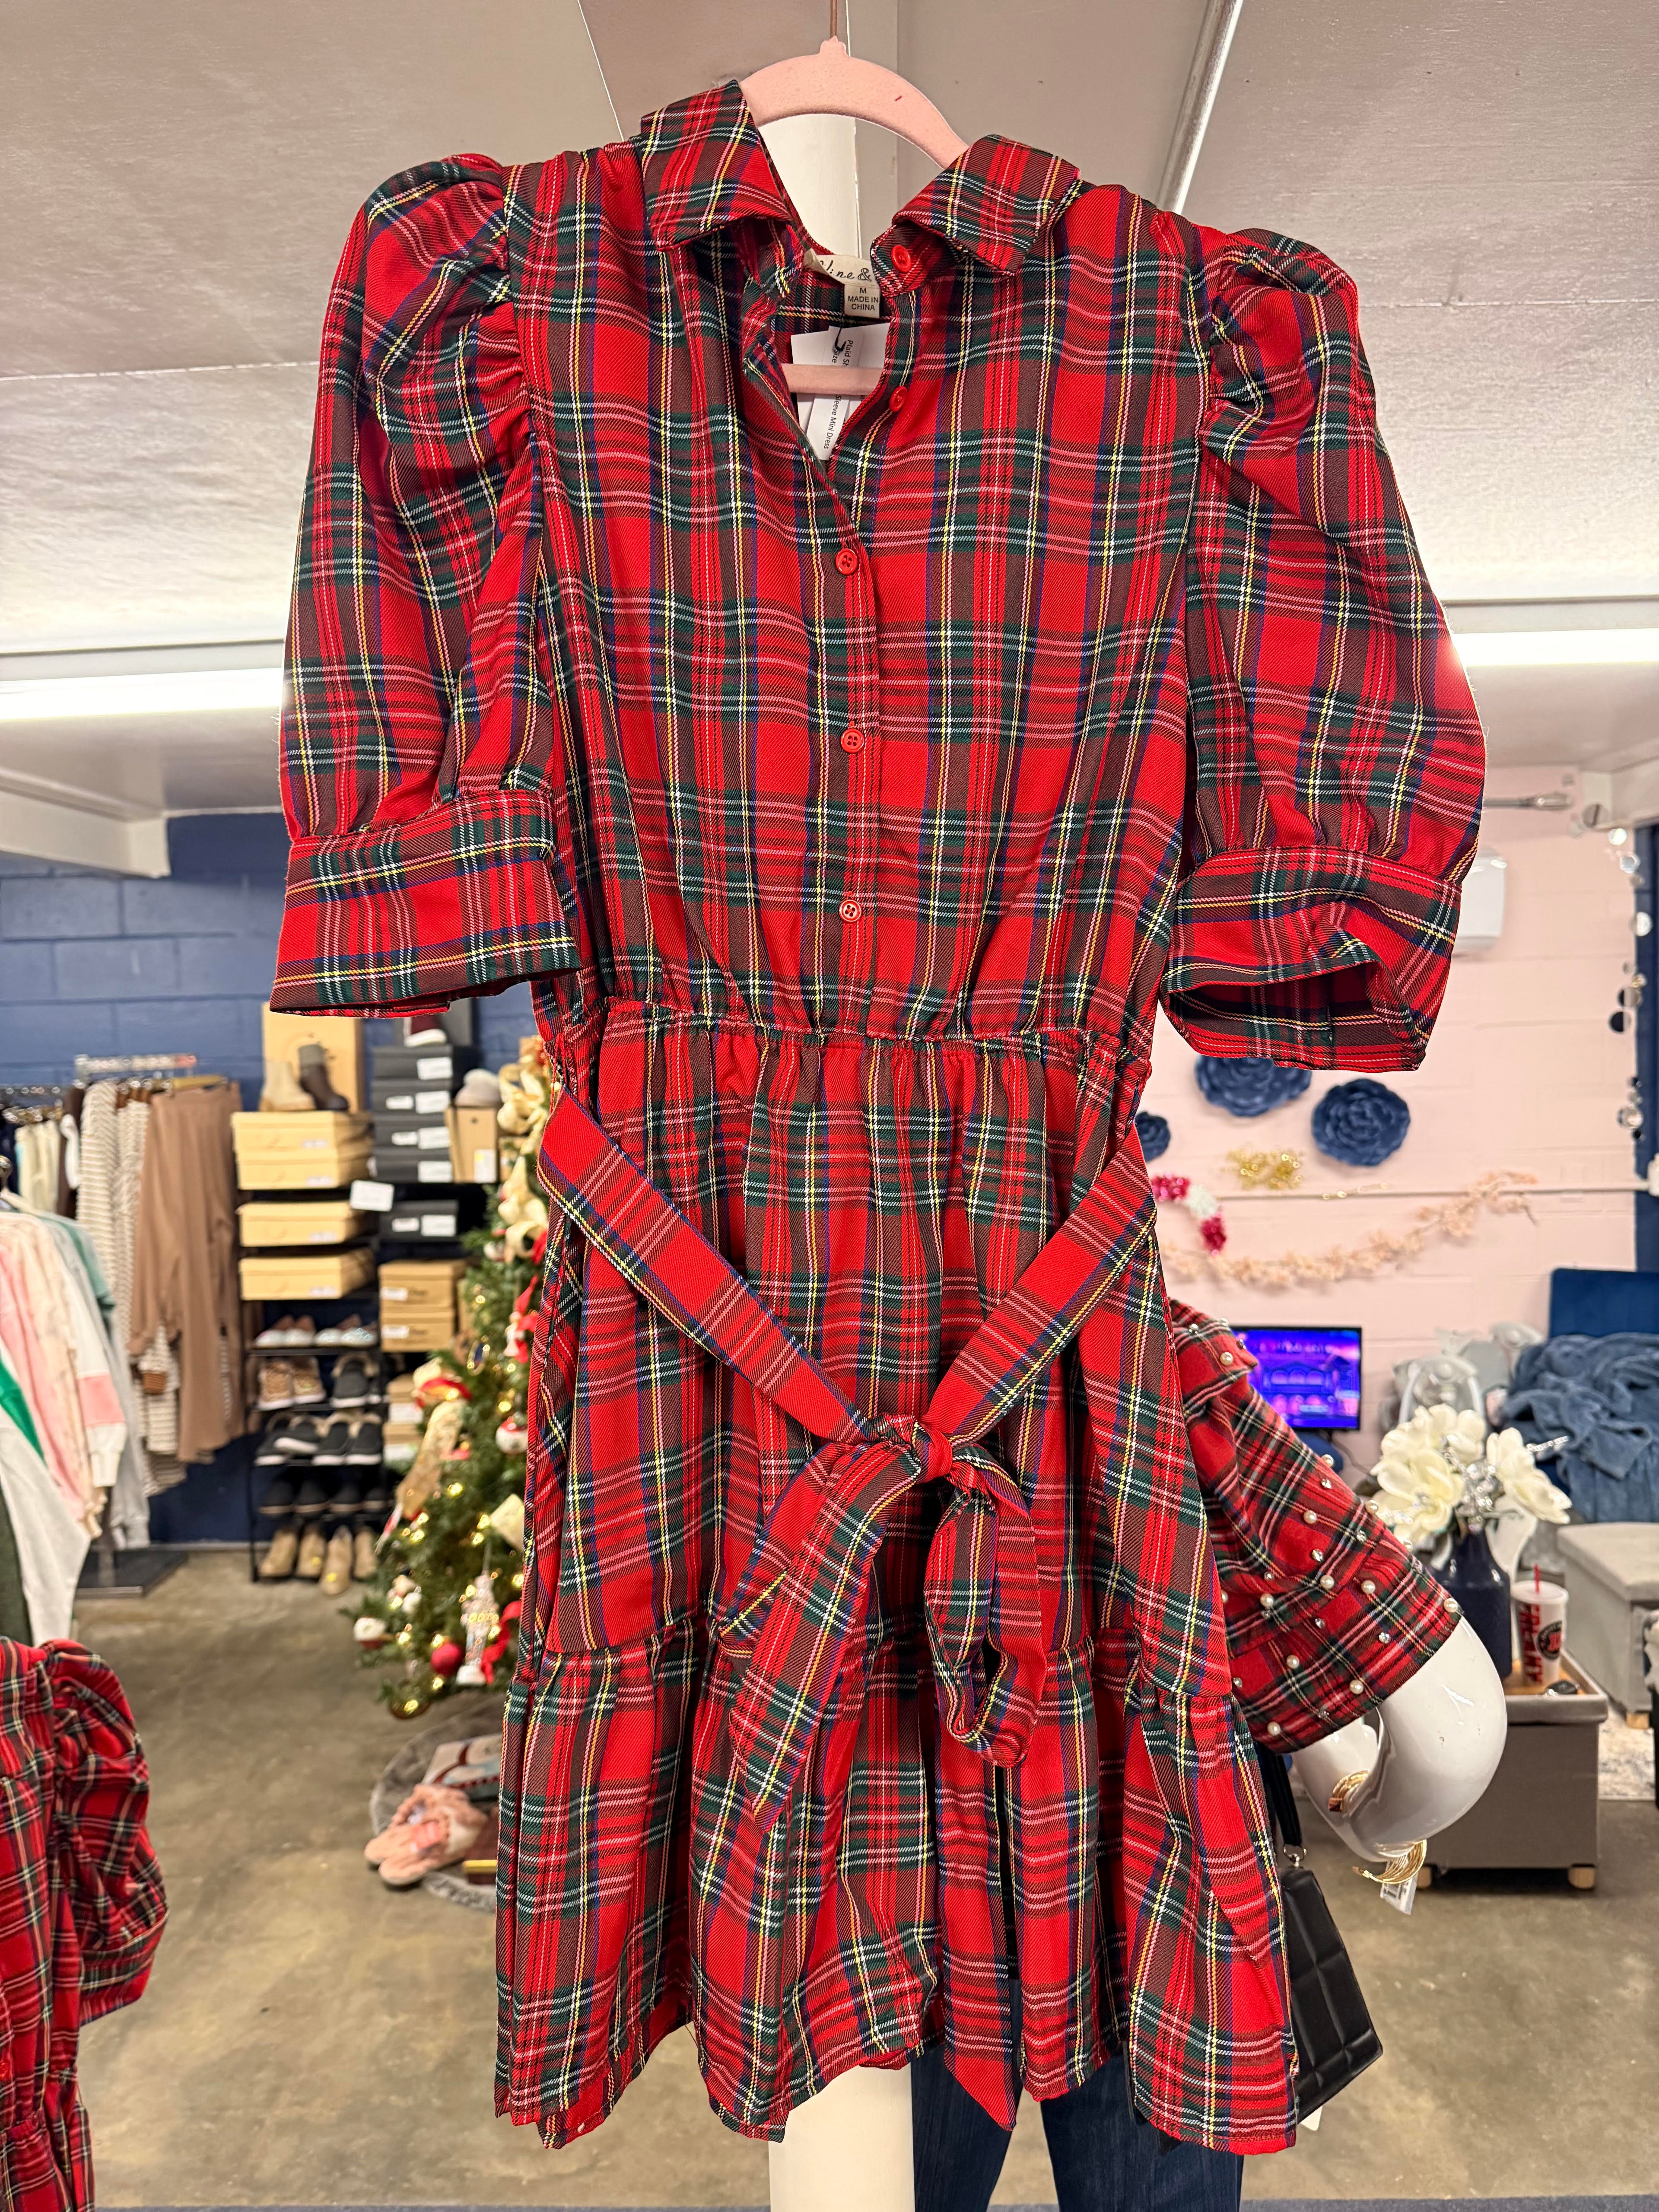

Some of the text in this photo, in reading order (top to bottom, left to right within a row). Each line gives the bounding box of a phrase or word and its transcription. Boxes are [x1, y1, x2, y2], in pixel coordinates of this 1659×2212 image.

[858, 268, 872, 281] &
[845, 340, 853, 357] Plaid
[832, 394, 842, 415] Sleeve
[828, 417, 837, 431] Mini
[824, 432, 833, 449] Dress
